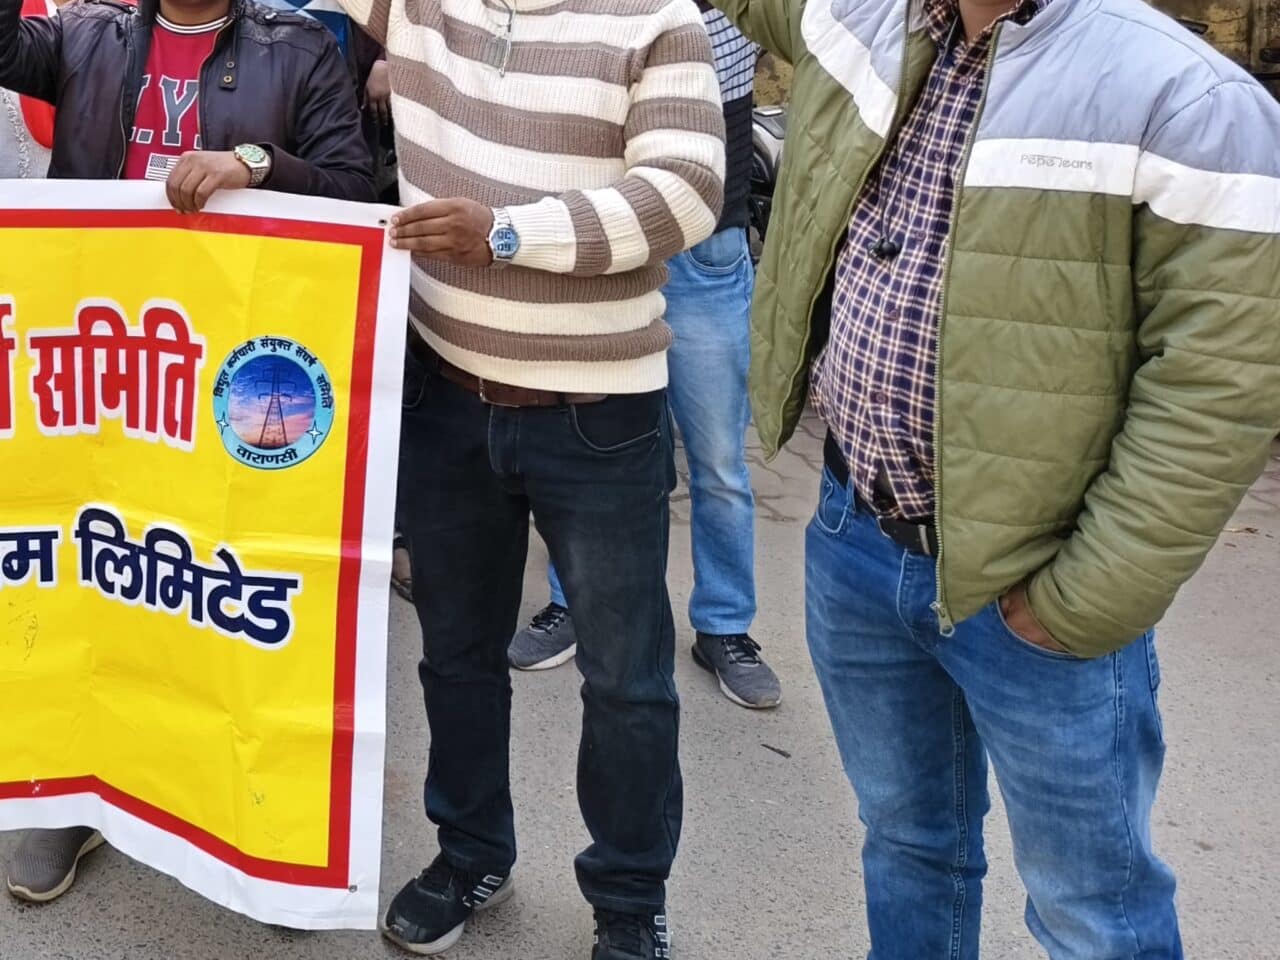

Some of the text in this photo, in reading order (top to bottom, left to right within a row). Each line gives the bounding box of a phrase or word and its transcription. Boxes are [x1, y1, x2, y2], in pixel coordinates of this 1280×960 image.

[1020, 153, 1056, 168] Pepe
[29, 305, 203, 443] समिति
[235, 444, 299, 465] वाराणसी
[75, 508, 298, 645] लिमिटेड
